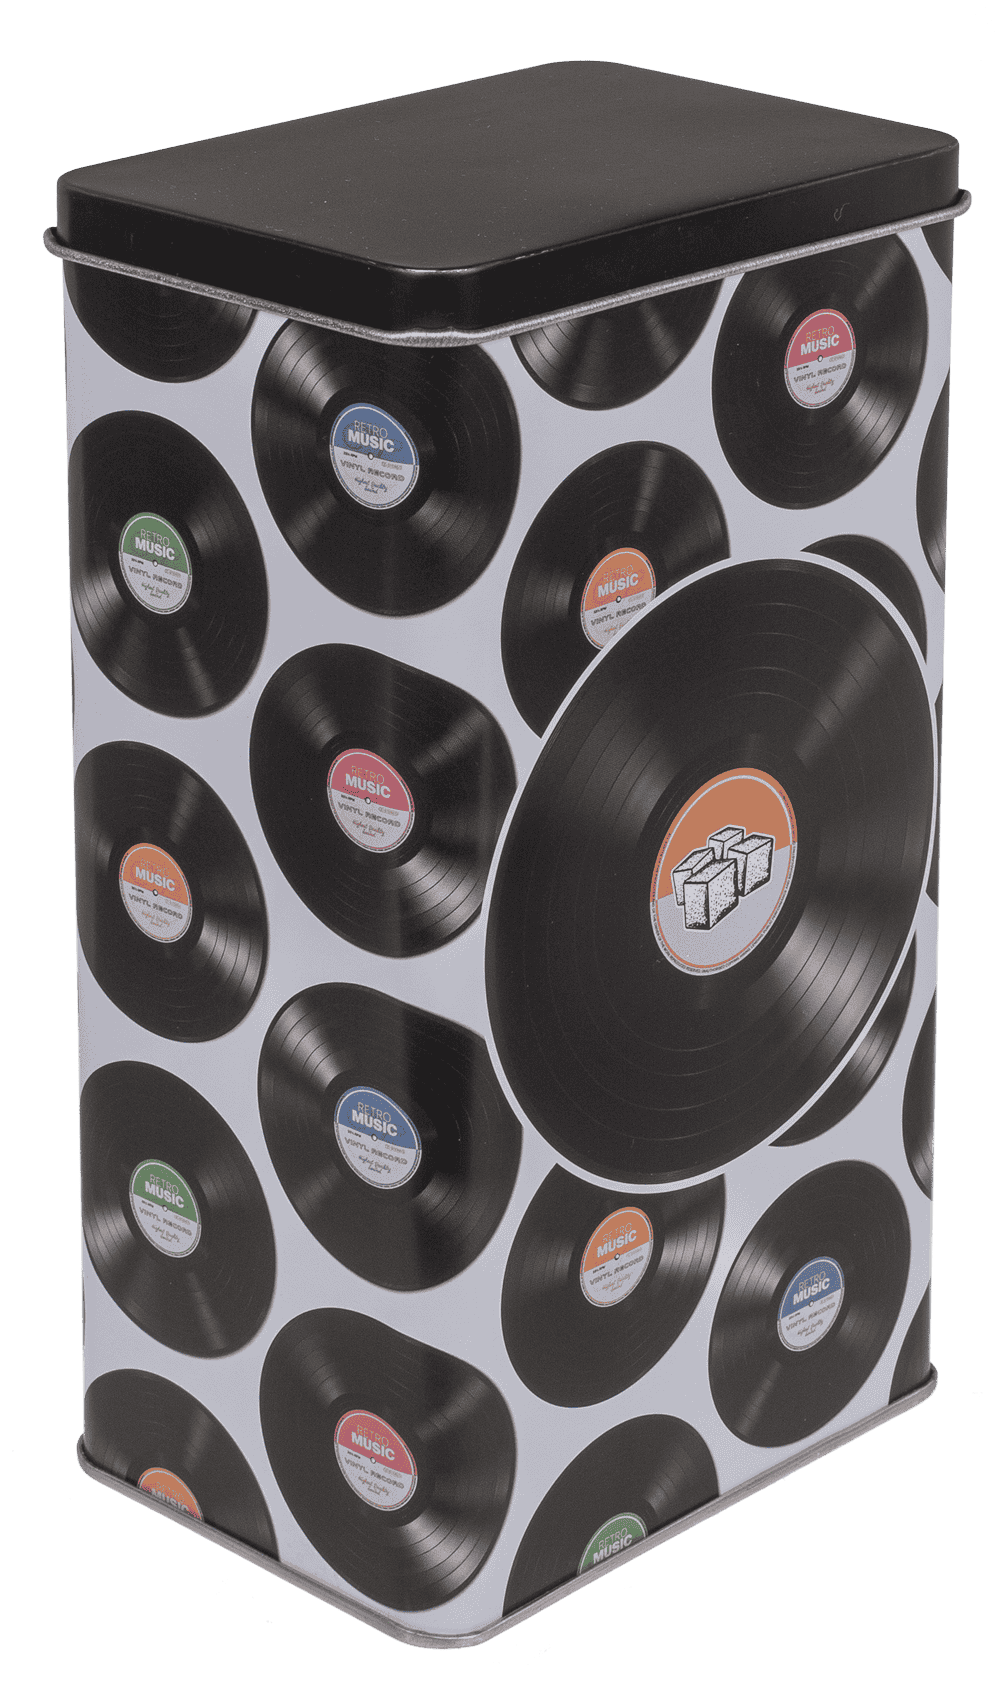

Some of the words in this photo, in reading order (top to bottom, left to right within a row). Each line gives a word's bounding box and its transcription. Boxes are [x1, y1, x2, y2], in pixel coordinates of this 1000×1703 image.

[801, 334, 840, 355] MUSIC
[806, 326, 834, 342] RETRO
[794, 372, 816, 383] VINYL
[818, 363, 846, 376] RECORD
[348, 429, 394, 452] MUSIC
[354, 420, 388, 438] RETRO
[340, 460, 365, 472] VINYL
[368, 467, 405, 481] RECORD
[135, 537, 175, 560] MUSIC
[141, 529, 170, 547] RETRO
[128, 566, 151, 578] VINYL
[153, 574, 182, 589] RECORD
[598, 573, 638, 597] MUSIC
[591, 614, 614, 625] VINYL
[345, 773, 390, 798] MUSIC
[351, 765, 384, 784] RETRO
[338, 802, 363, 816] VINYL
[365, 811, 401, 827] RECORD
[136, 866, 175, 891] MUSIC
[129, 894, 151, 907] VINYL
[153, 903, 183, 920] RECORD
[352, 1109, 397, 1136] MUSIC
[358, 1102, 391, 1122] RETRO
[345, 1137, 369, 1152] VINYL
[371, 1148, 407, 1165] RECORD
[145, 1181, 184, 1208] MUSIC
[150, 1174, 179, 1194] RETRO
[139, 1207, 161, 1222] VINYL
[163, 1218, 192, 1236] RECORD
[597, 1230, 637, 1258] MUSIC
[590, 1272, 612, 1285] VINYL
[614, 1256, 644, 1274] RECORD
[799, 1271, 826, 1291] RETRO
[793, 1278, 830, 1305] MUSIC
[786, 1317, 807, 1331] VINYL
[808, 1302, 836, 1320] RECORD
[351, 1431, 395, 1460] MUSIC
[357, 1425, 389, 1447] RETRO
[344, 1457, 369, 1474] VINYL
[370, 1470, 404, 1489] RECORD
[593, 1534, 632, 1564] MUSIC
[599, 1527, 628, 1550] RETRO
